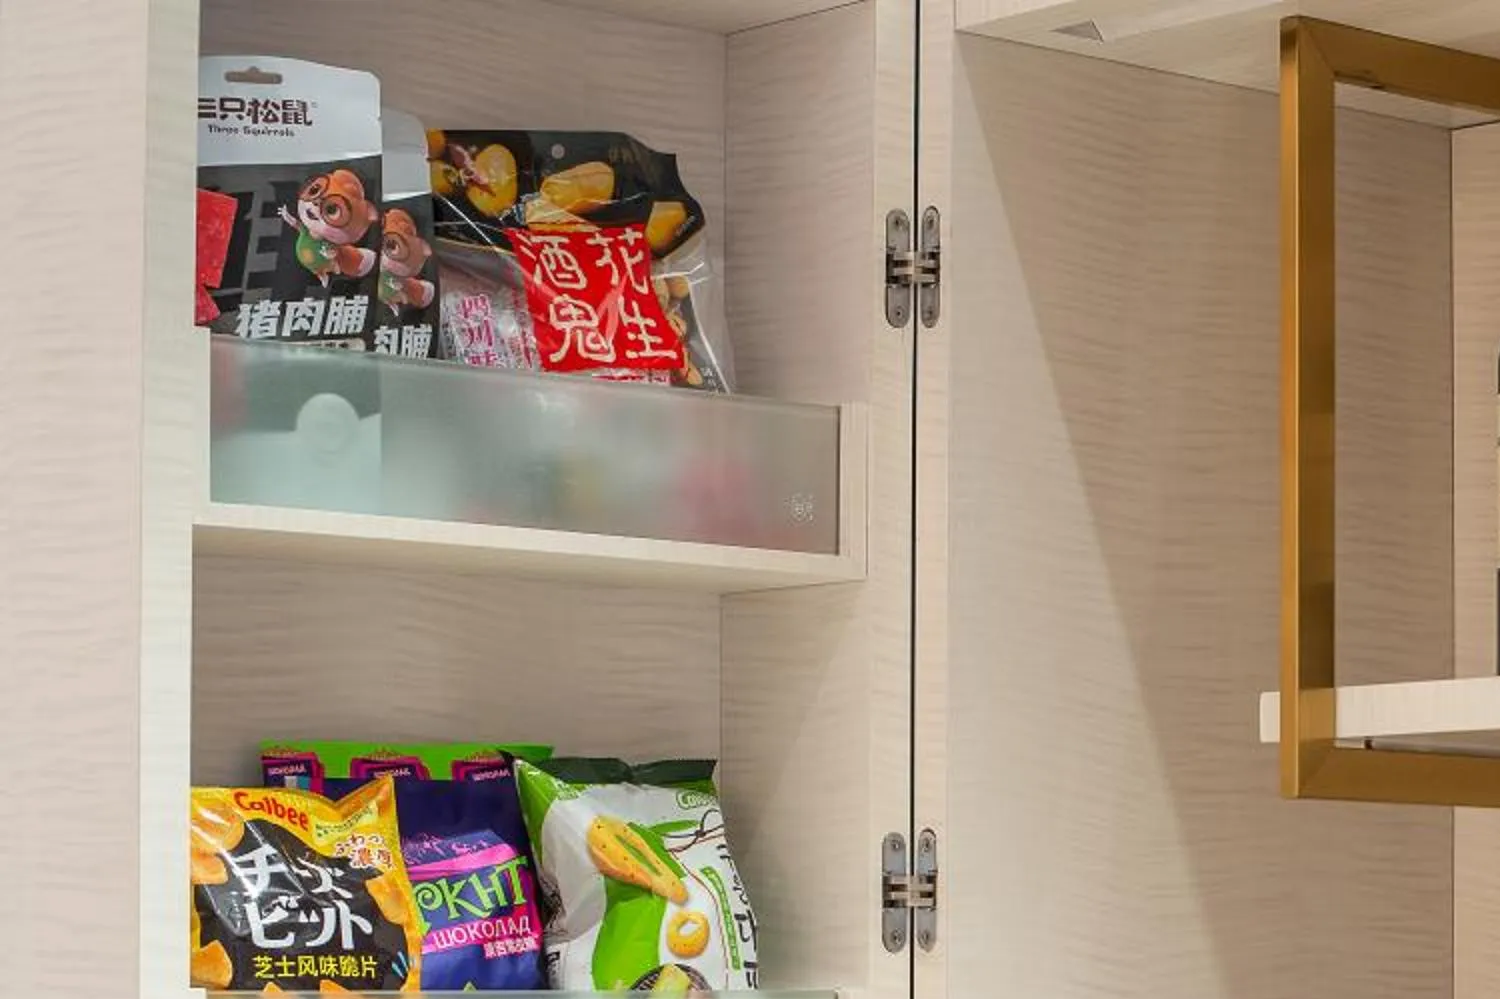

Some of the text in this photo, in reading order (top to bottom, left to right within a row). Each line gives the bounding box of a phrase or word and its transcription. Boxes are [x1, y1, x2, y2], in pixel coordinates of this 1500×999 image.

[234, 791, 309, 831] Calbee
[433, 915, 531, 949] ШОКОЛАД
[253, 955, 378, 979] 芝士风味脆片
